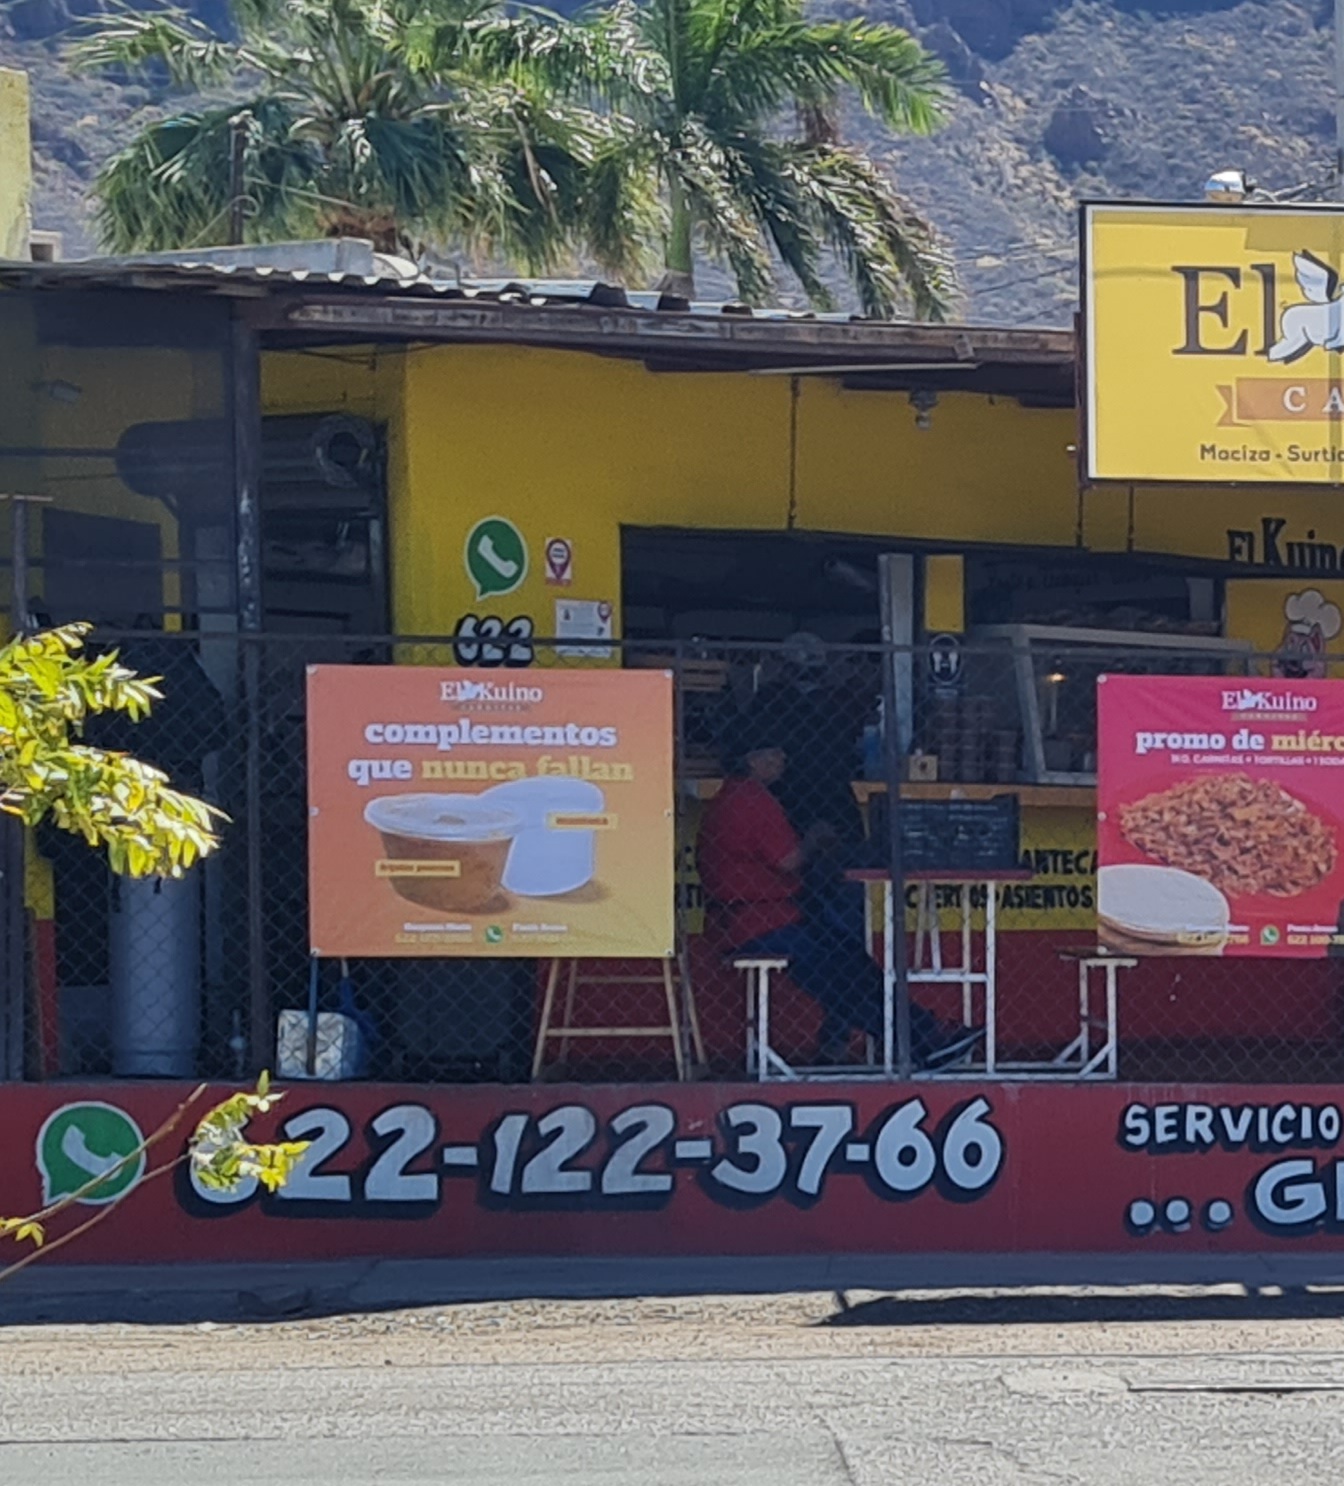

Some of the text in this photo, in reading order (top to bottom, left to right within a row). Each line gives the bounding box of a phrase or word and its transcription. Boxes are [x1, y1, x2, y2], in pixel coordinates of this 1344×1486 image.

[1171, 262, 1277, 357] El
[1199, 443, 1272, 463] Maciza
[454, 613, 534, 668] 622
[479, 681, 543, 703] Kuino
[1257, 691, 1318, 712] Kuino
[364, 718, 618, 751] complementos
[1135, 730, 1226, 754] promo
[1231, 728, 1265, 750] de
[347, 754, 635, 786] que nunca fallan
[1001, 884, 1095, 909] ASIENTOS
[1123, 1103, 1338, 1145] SERVICIO
